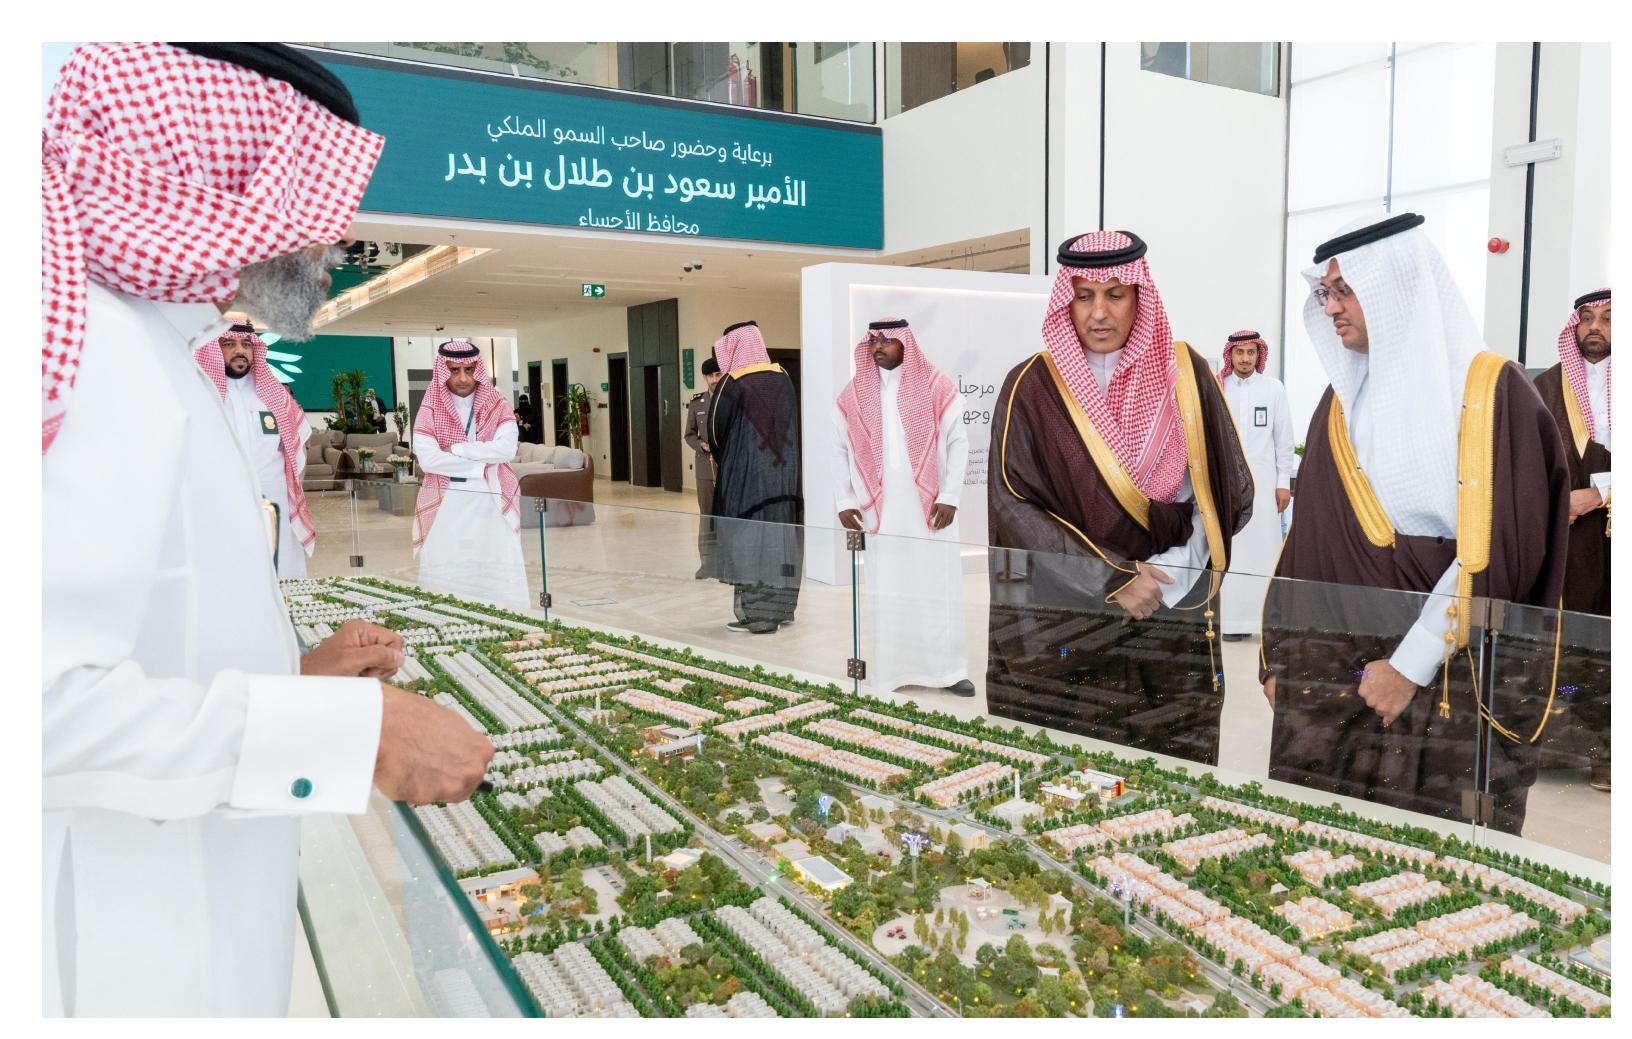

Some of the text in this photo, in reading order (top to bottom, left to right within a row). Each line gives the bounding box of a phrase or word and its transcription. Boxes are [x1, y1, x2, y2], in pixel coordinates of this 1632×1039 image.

[488, 116, 771, 167] برعاية وحضور صاحب السمو الملكي
[445, 153, 805, 209] الأمير سعود بن طلال بن بدر
[579, 208, 699, 234] محافظ الأحساء
